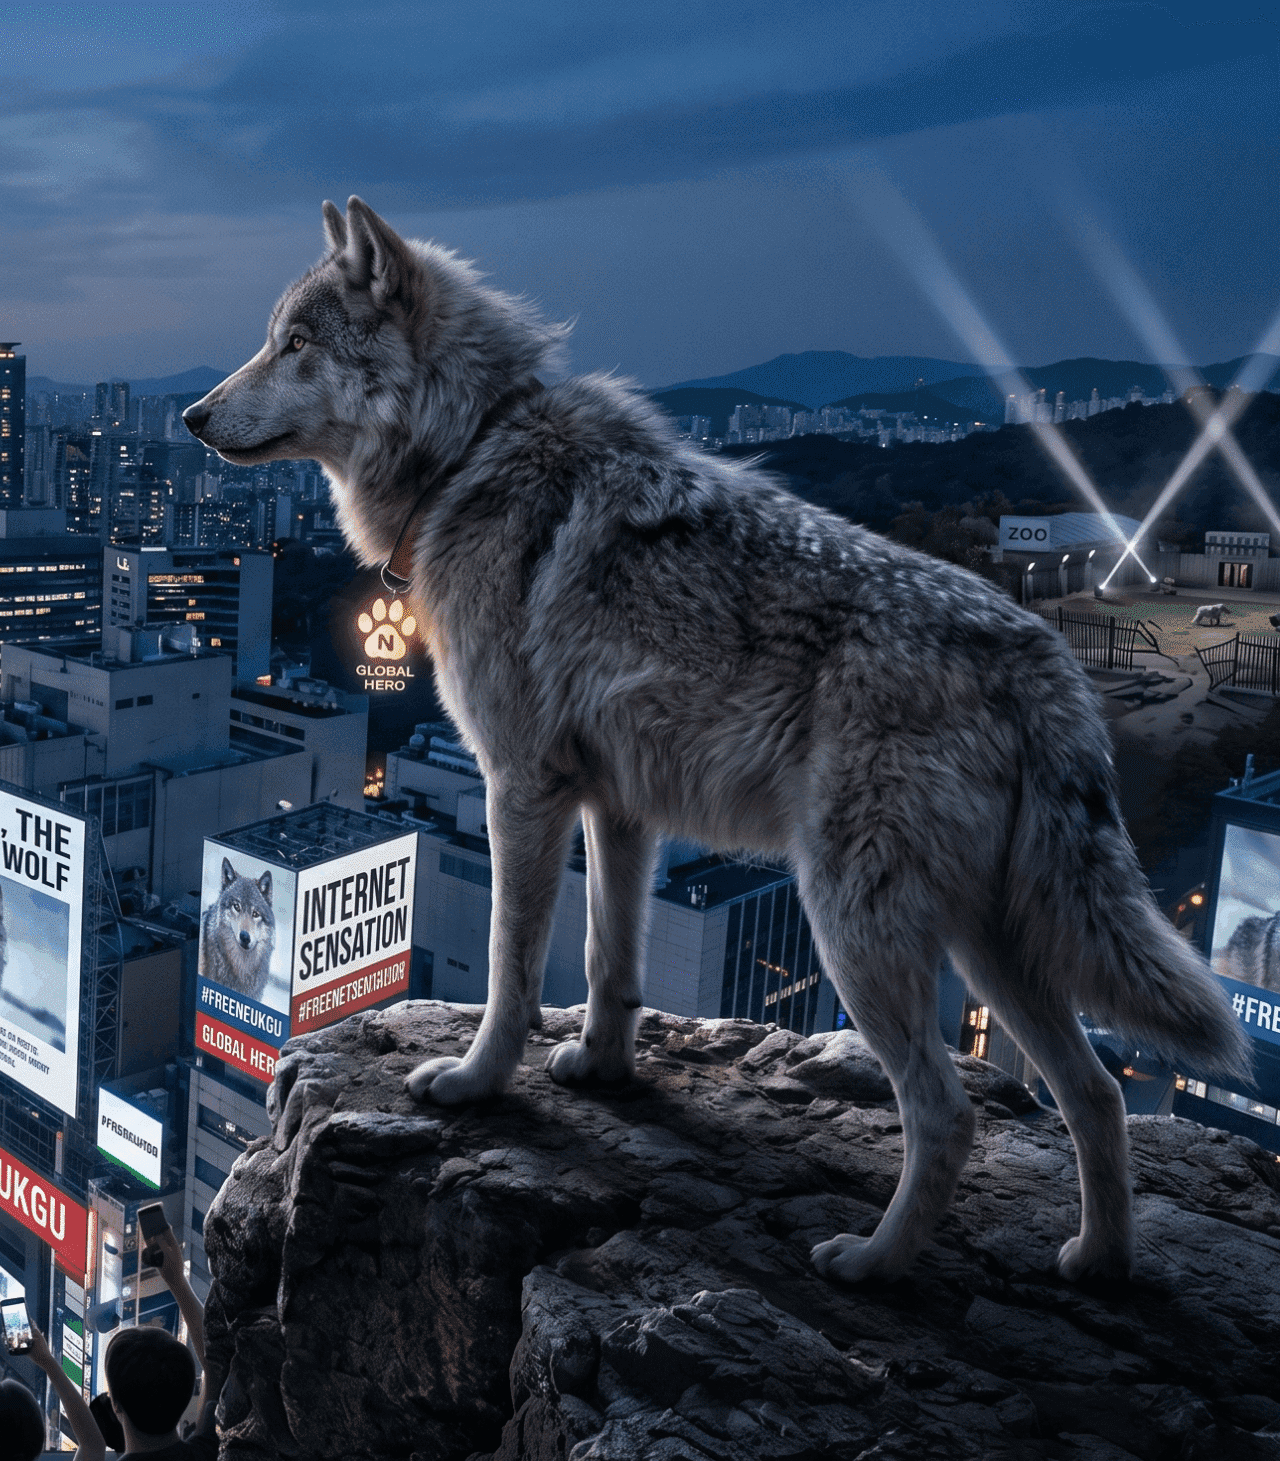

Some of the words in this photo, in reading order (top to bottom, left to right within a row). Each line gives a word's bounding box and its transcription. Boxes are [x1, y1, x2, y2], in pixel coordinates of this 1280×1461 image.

[1008, 526, 1048, 542] ZOO
[377, 633, 395, 652] N
[355, 664, 415, 677] GLOBAL
[364, 679, 406, 691] HERO
[15, 807, 72, 860] THE
[3, 841, 70, 892] WOLF
[302, 855, 412, 936] INTERNET
[298, 905, 409, 981] SENSATION
[201, 985, 283, 1038] #FREENEUKGU
[202, 1023, 248, 1063] GLOBAL
[250, 1047, 277, 1077] HER
